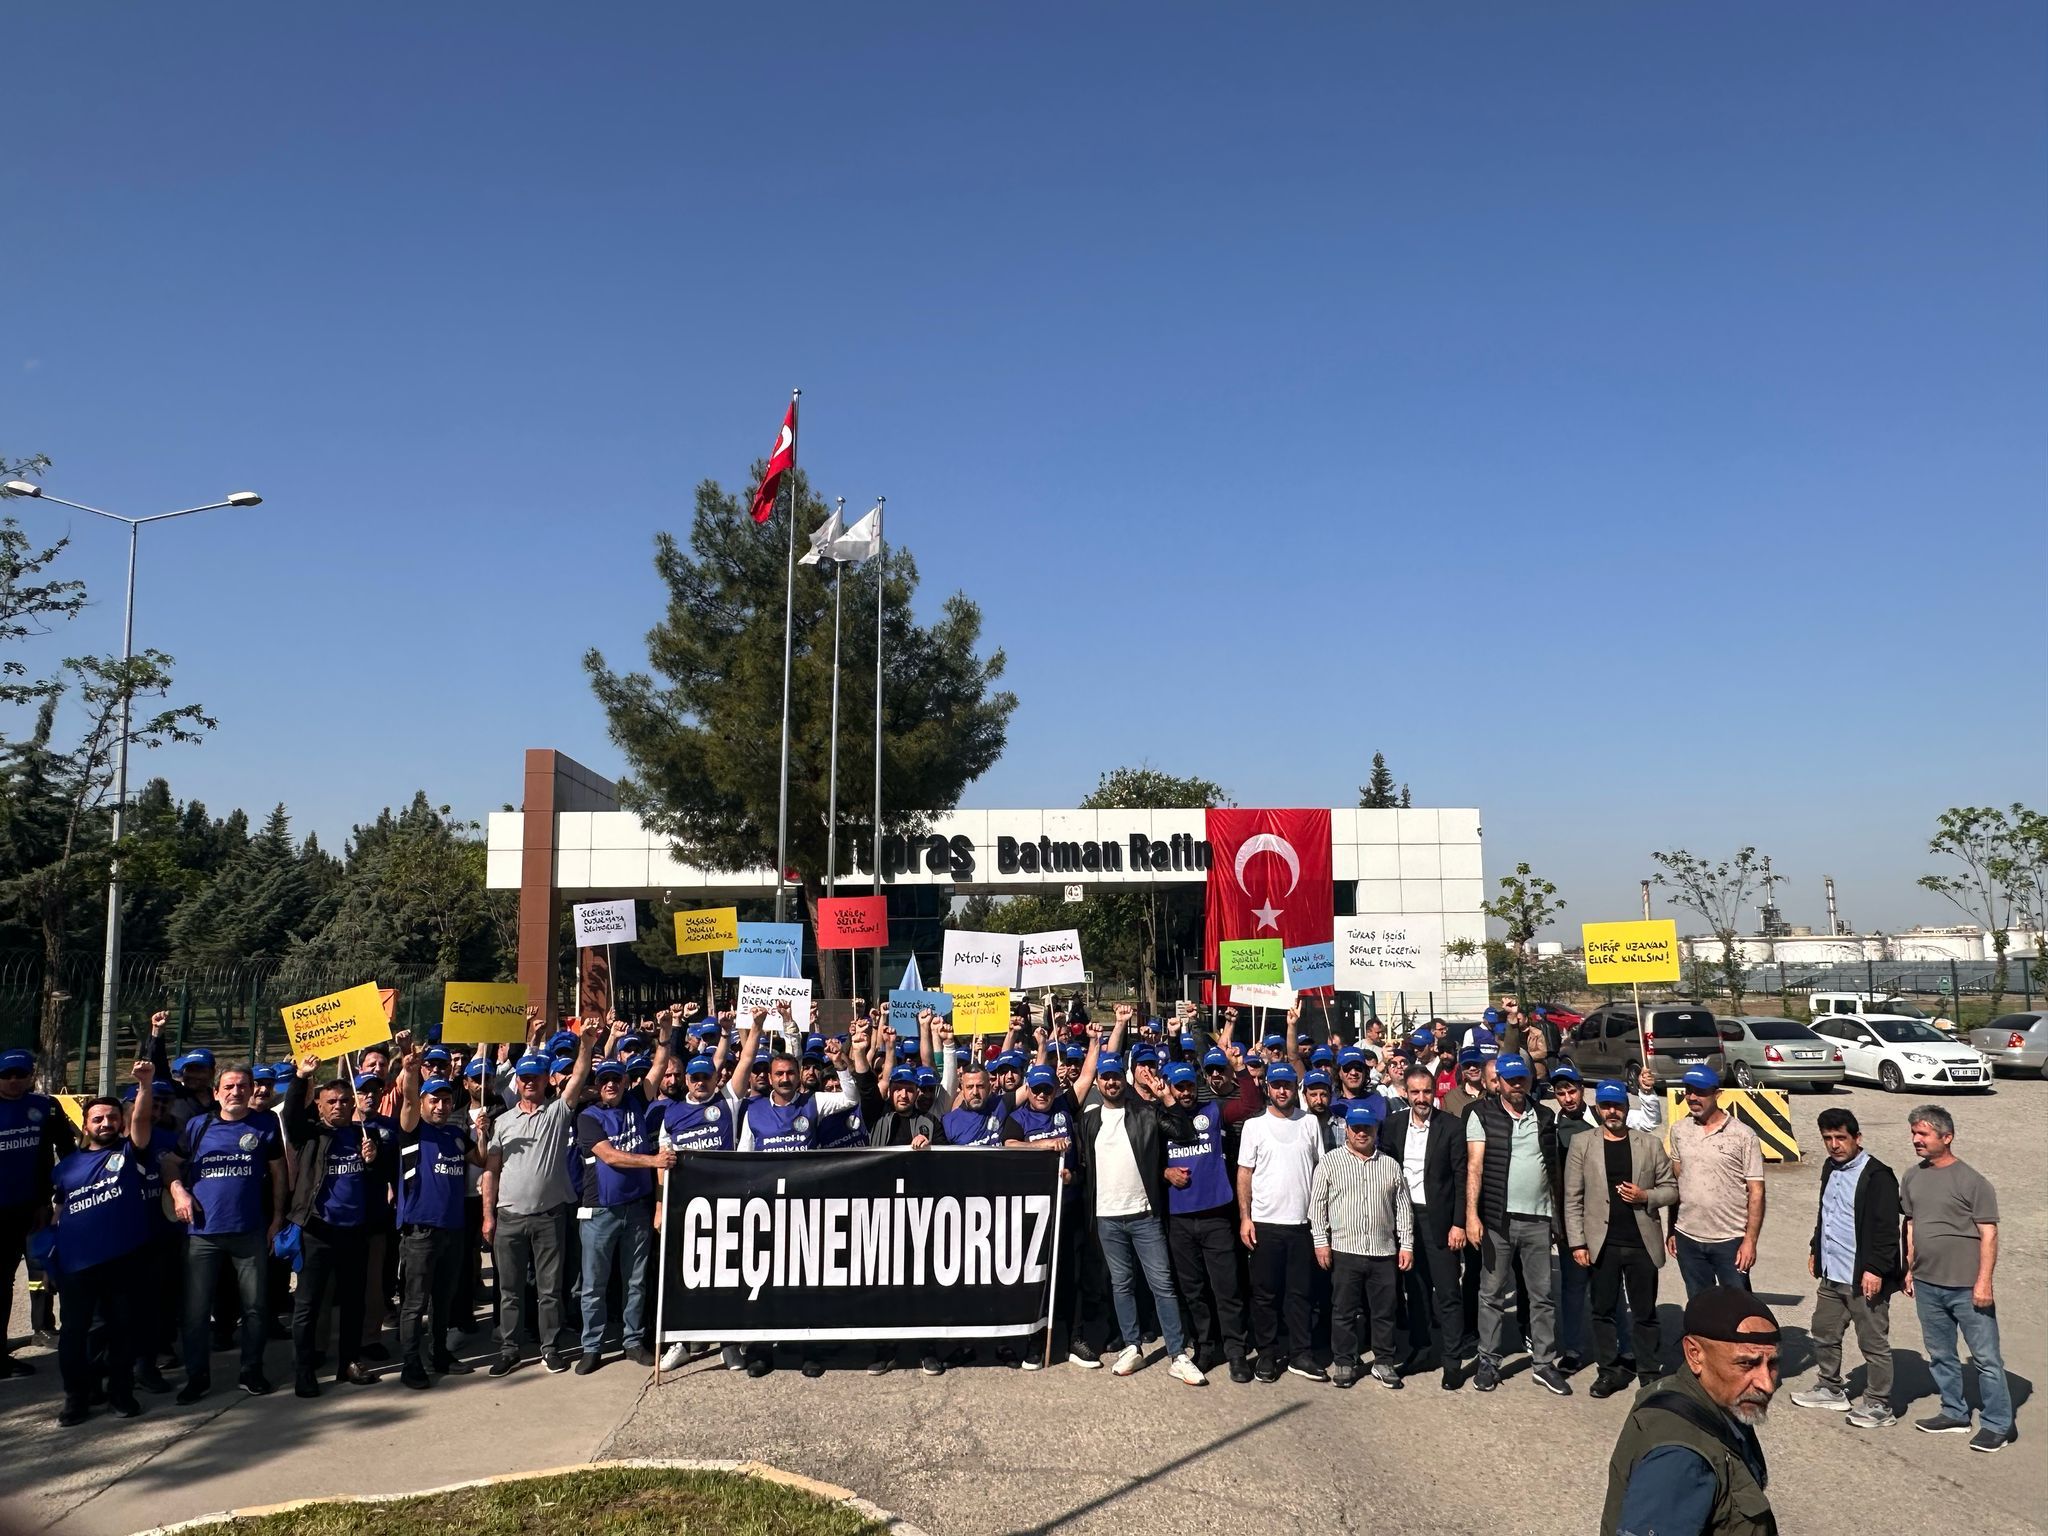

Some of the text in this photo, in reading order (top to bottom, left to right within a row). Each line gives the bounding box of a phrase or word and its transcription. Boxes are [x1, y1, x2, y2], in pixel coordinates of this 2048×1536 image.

[998, 835, 1123, 874] Batman
[686, 916, 717, 927] YAŞASIN
[686, 926, 715, 934] ONURLU
[837, 922, 879, 934] TUTULSUN!
[1346, 928, 1376, 941] TÜPRAŞ
[1349, 944, 1383, 955] SEFALET
[1625, 940, 1668, 951] UZANAN
[1291, 952, 1310, 964] HANİ
[1350, 957, 1375, 967] KABUL
[1589, 954, 1617, 965] ELLER
[742, 983, 810, 997] DİRENE DİRENE
[291, 999, 341, 1020] İŞÇİLERİN
[295, 1014, 357, 1044] SERMAYEYİ
[300, 1031, 351, 1053] YENECEK
[763, 1134, 807, 1146] petrol-iş
[200, 1164, 253, 1178] SENDİKASI
[69, 1186, 123, 1215] SENDİKASI
[682, 1178, 1051, 1300] GEÇİNEMİYORUZ
